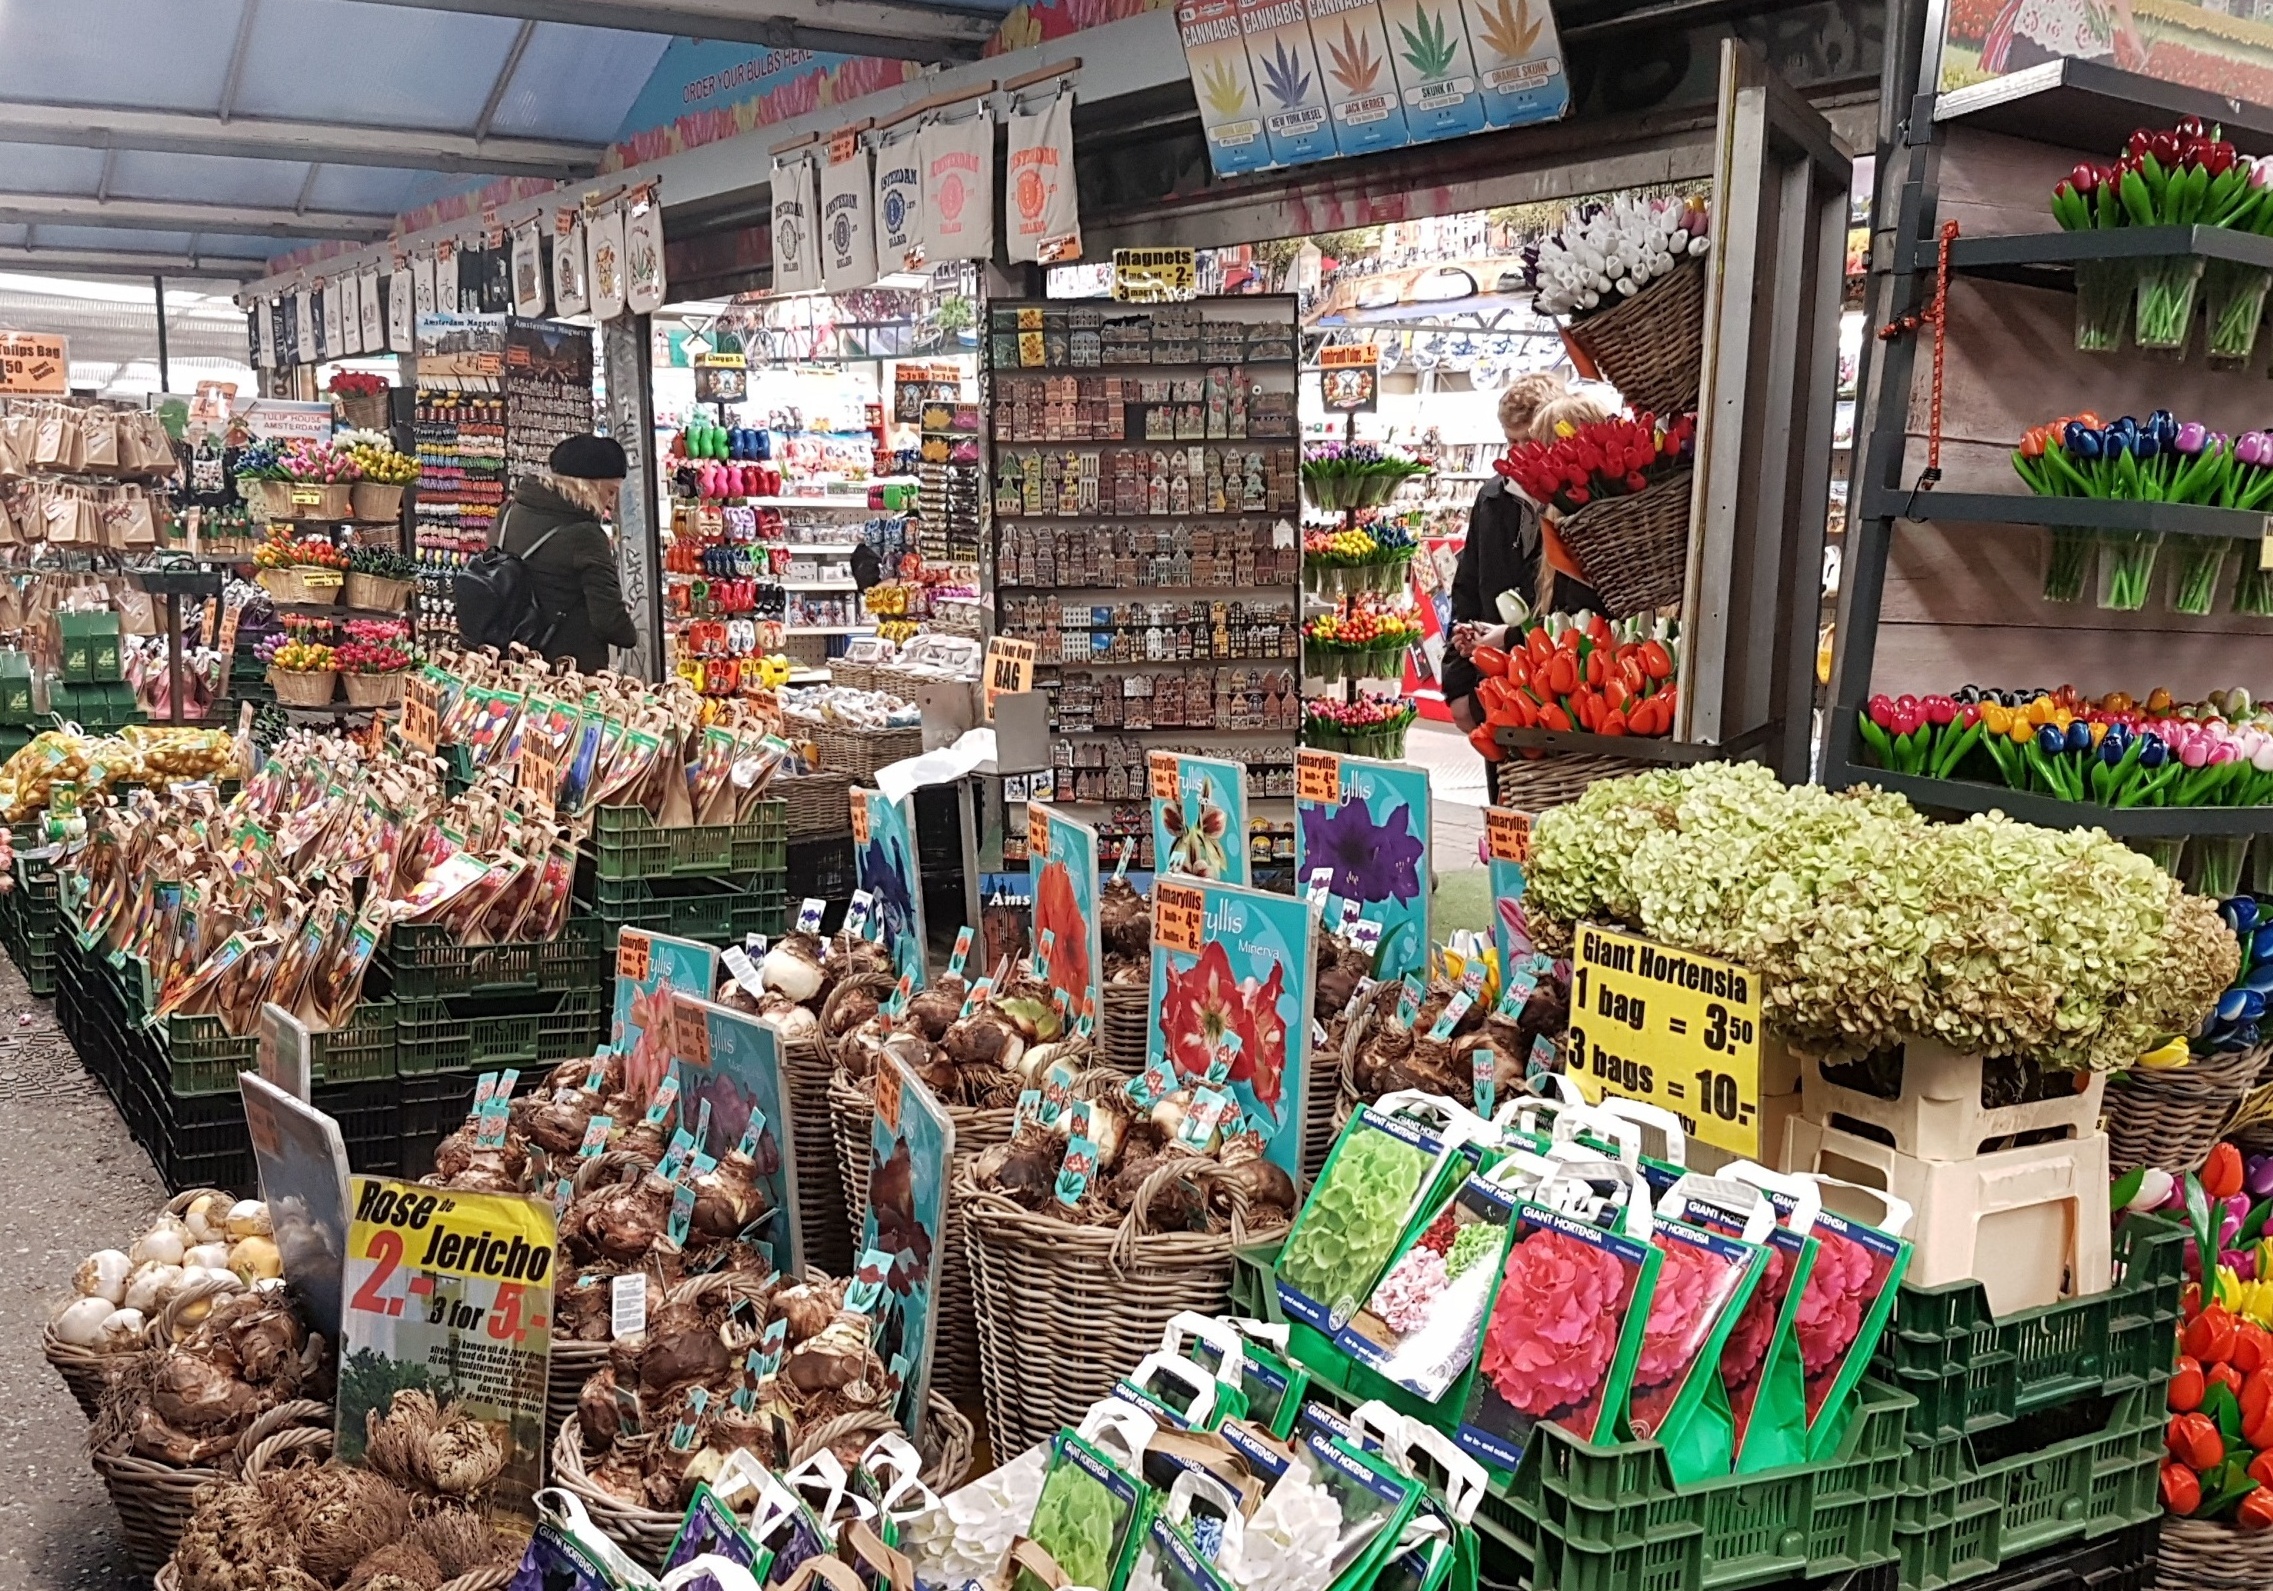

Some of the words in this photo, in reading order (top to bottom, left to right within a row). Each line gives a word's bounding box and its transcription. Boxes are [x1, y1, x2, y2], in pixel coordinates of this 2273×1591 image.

[1241, 1, 1304, 34] CANNABIS
[1308, 0, 1375, 19] CANNA
[1182, 18, 1240, 47] CANNABIS
[683, 75, 716, 104] ORDER
[717, 64, 745, 91] YOUR
[747, 51, 781, 82] BULBS
[783, 49, 814, 70] HERE
[1522, 62, 1550, 77] SKUNK
[1421, 84, 1446, 98] SKUNK
[1447, 82, 1456, 93] #1
[1272, 115, 1287, 127] NEW
[1287, 112, 1301, 125] YORK
[1301, 109, 1323, 122] DIESEL
[1345, 101, 1361, 115] JACK
[1116, 250, 1191, 267] Magnets
[424, 318, 465, 327] Amsterdam
[466, 318, 498, 328] Magnets
[514, 319, 556, 332] Amsterdam
[557, 325, 587, 337] Magnets
[37, 346, 60, 358] Bag
[956, 404, 978, 413] Lotus
[263, 413, 289, 423] TULIP
[290, 414, 322, 425] HOUSE
[263, 422, 322, 433] AMSTERDAM
[989, 640, 1000, 654] Mix
[1001, 641, 1016, 658] Your
[1017, 644, 1033, 661] Own
[994, 659, 1020, 692] BAG
[1297, 753, 1336, 770] Amaryllis
[1297, 768, 1301, 780] 1
[1296, 781, 1301, 794] 2
[1487, 811, 1528, 832] Amaryllis
[1488, 828, 1492, 841] 1
[1488, 843, 1494, 857] 2
[1157, 884, 1202, 911] Amaryllis
[1157, 905, 1161, 922] 1
[1186, 911, 1199, 930] 4.50
[1155, 923, 1160, 940] 2
[621, 934, 648, 952] Amaryllis
[1238, 939, 1280, 959] Minerva
[1584, 931, 1636, 974] Giant
[1639, 946, 1748, 1005] Hortensia
[1576, 967, 1588, 1009] 1
[1598, 983, 1646, 1031] bag
[1704, 1003, 1753, 1056] 3.50
[1568, 1026, 1586, 1070] 3
[1593, 1045, 1654, 1093] bags
[1694, 1067, 1756, 1126] 10.-
[1363, 1110, 1388, 1127] GIANT
[1386, 1120, 1421, 1143] HORTENSIA
[1398, 1115, 1420, 1131] GIANT
[1469, 1174, 1496, 1195] GIANT
[355, 1180, 438, 1230] Rose
[438, 1198, 456, 1213] de
[1688, 1201, 1720, 1220] GIANT
[1772, 1192, 1798, 1209] GIANT
[1523, 1206, 1554, 1226] GIANT
[1554, 1216, 1602, 1244] HORTENSIA
[1669, 1221, 1710, 1245] HORTENSIA
[421, 1225, 552, 1282] Jericho
[350, 1229, 435, 1317] 2.-
[429, 1297, 446, 1325] 3
[448, 1300, 486, 1331] for
[487, 1282, 547, 1342] 5.-
[499, 1346, 509, 1356] de
[477, 1383, 492, 1393] dan
[1116, 1383, 1139, 1404] GIANT
[1308, 1404, 1331, 1426] GIANT
[1224, 1423, 1246, 1444] GIANT
[1242, 1435, 1279, 1467] HORTENSIA
[1463, 1433, 1473, 1443] for
[1481, 1442, 1495, 1453] and
[1065, 1440, 1082, 1463] GIANT
[1079, 1452, 1109, 1481] HORTENSIA
[1313, 1436, 1341, 1460] GIANT
[1338, 1452, 1375, 1485] HORTENSIA
[540, 1525, 563, 1550] GIANT
[563, 1543, 597, 1580] HORTENSIA
[1154, 1519, 1174, 1546] GIANT
[1172, 1537, 1199, 1575] HORTENSIA
